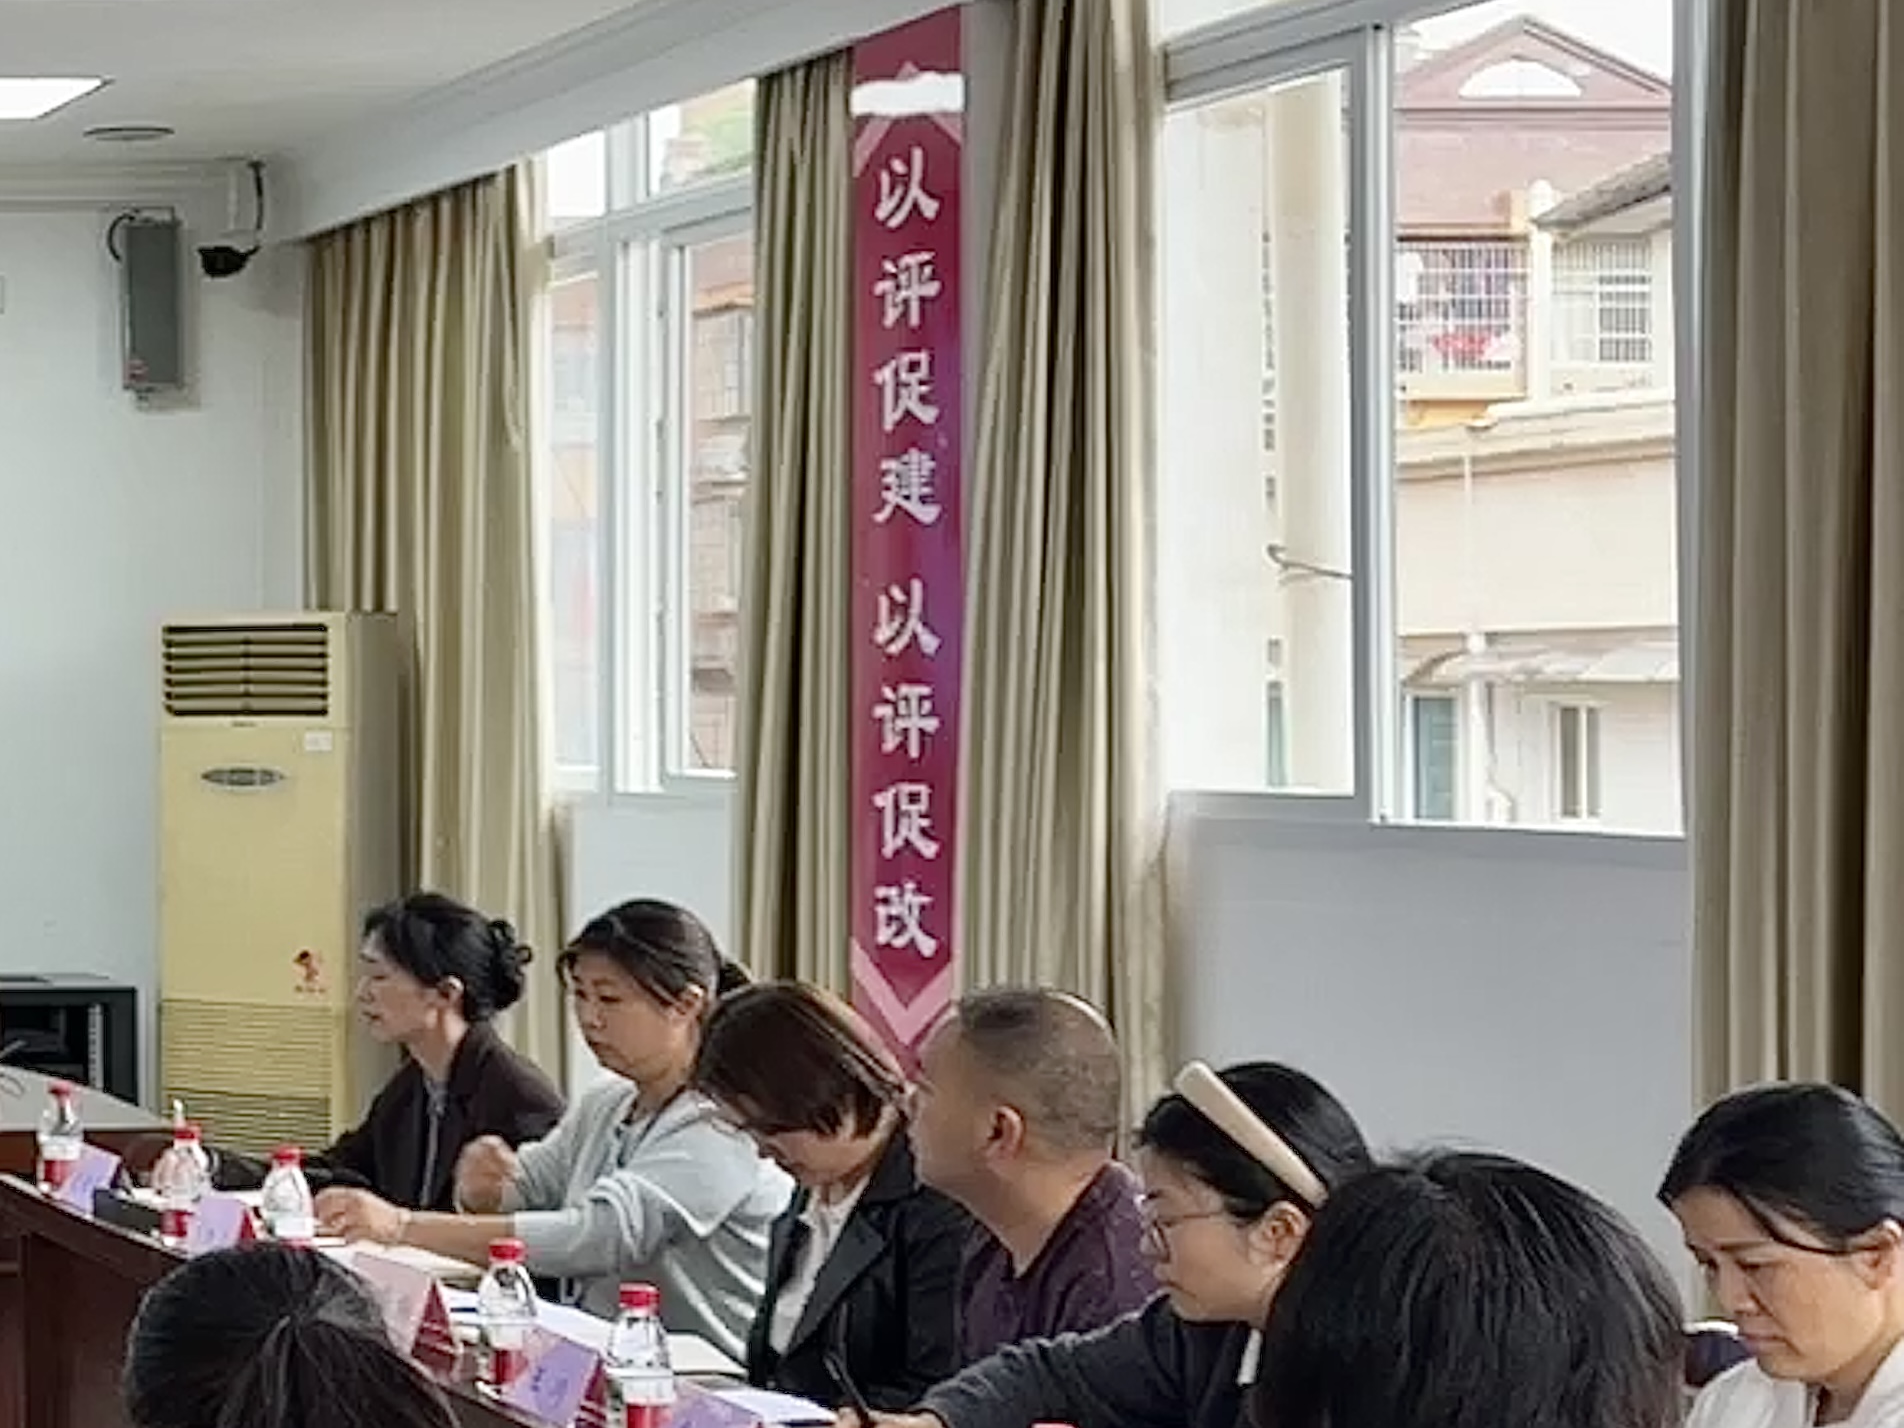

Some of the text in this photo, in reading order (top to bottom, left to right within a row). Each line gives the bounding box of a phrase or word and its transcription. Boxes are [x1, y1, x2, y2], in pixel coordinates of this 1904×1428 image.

[872, 146, 942, 958] 以评促建 以评促改
